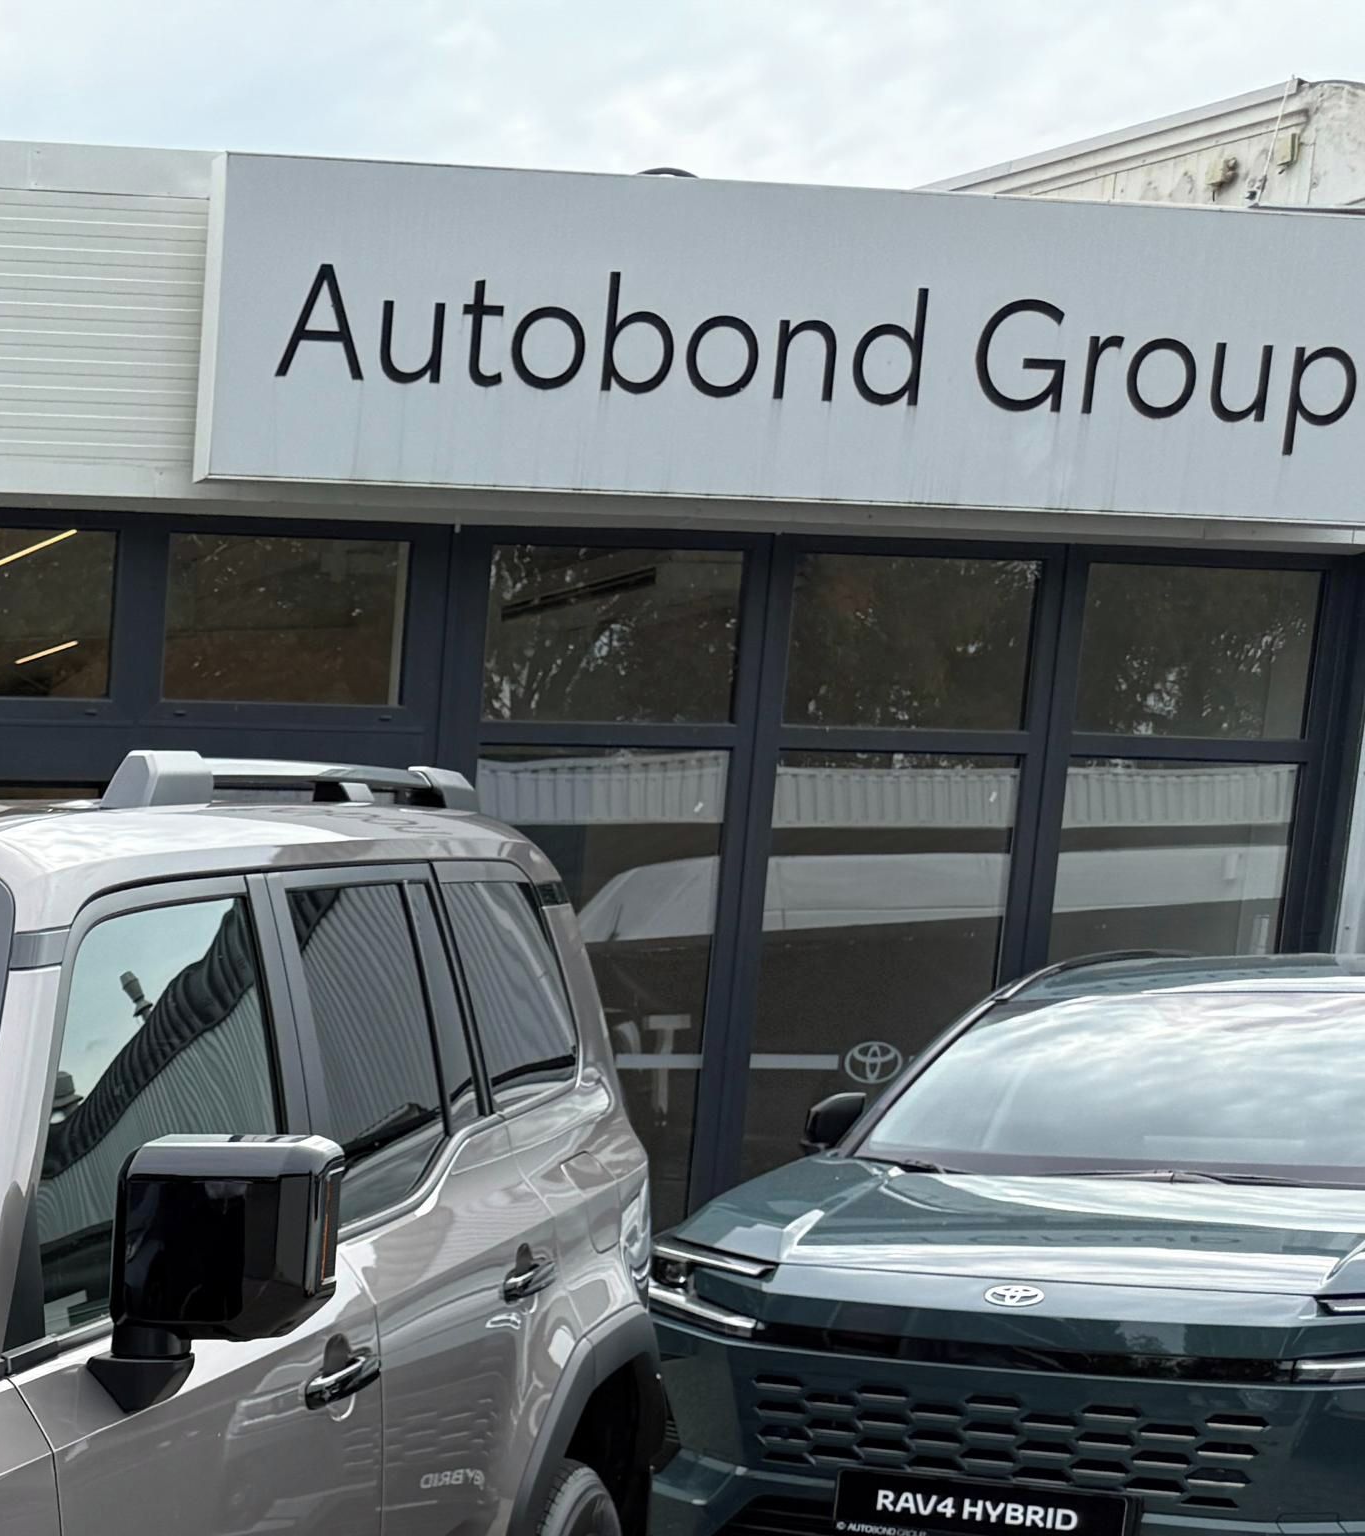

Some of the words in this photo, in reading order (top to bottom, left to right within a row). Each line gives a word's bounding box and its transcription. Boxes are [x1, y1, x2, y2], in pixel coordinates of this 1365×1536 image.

[275, 263, 929, 407] Autobond
[975, 298, 1358, 456] Group
[847, 1522, 897, 1536] AUTOBOND
[875, 1489, 956, 1518] RAV4
[961, 1498, 1078, 1532] HYBRID
